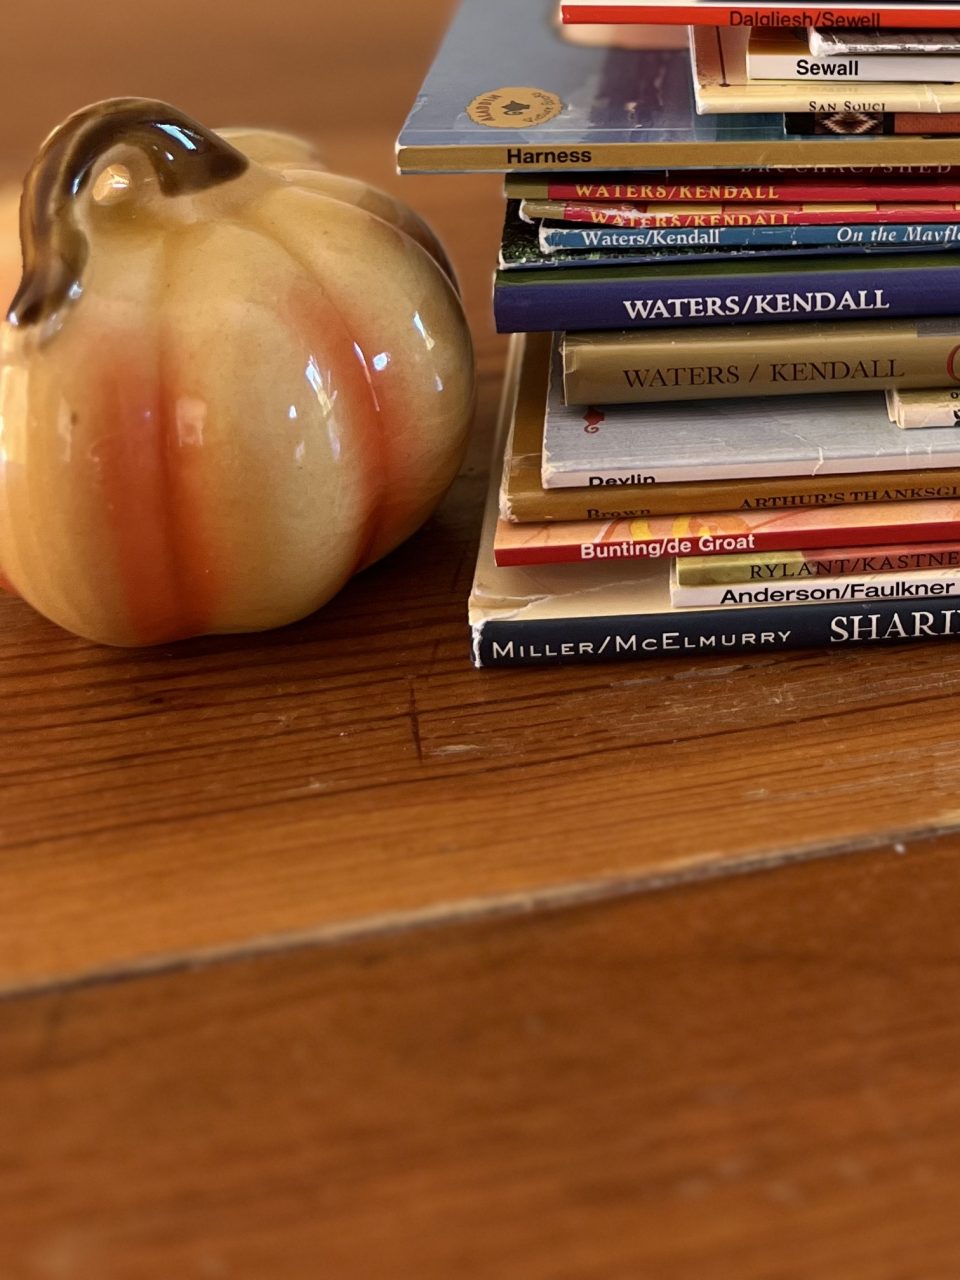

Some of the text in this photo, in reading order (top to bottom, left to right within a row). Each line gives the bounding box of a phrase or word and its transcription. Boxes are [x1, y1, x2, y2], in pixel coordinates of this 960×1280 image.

[796, 59, 859, 76] Sewall
[808, 101, 836, 112] SAN
[507, 148, 592, 164] Harness
[575, 184, 780, 200] WATERS/KENDALL
[582, 229, 720, 246] Waters/Kendall
[836, 226, 863, 242] On
[870, 226, 897, 242] the
[623, 289, 890, 319] WATERS/KENDALL
[623, 365, 740, 388] WATERS
[769, 358, 905, 383] KENDALL
[588, 474, 656, 488] Devlin
[739, 492, 845, 510] ARTHUR'S
[580, 538, 692, 560] Bunting/de
[698, 534, 756, 552] Groat
[720, 580, 956, 604] Anderson/Faulkner
